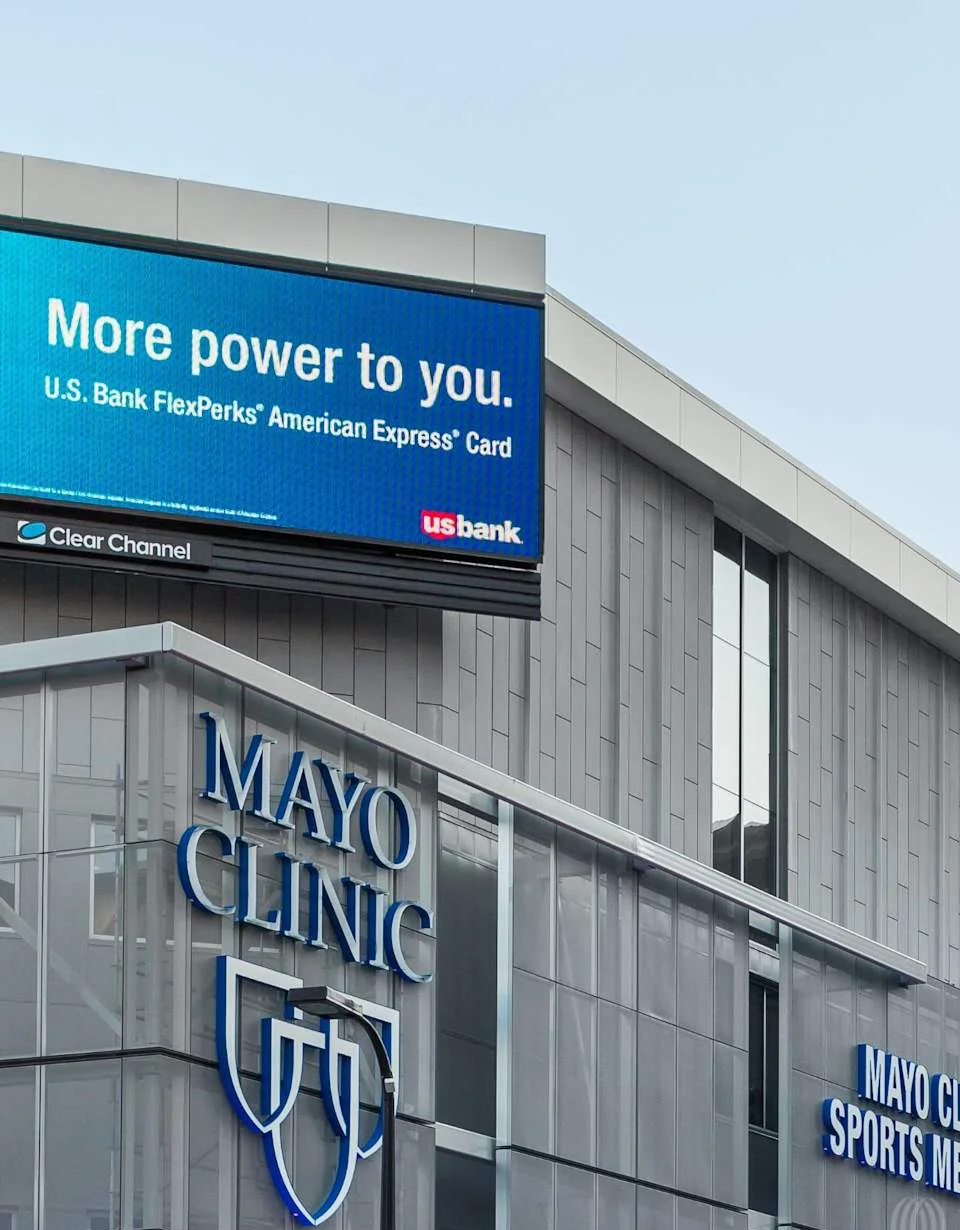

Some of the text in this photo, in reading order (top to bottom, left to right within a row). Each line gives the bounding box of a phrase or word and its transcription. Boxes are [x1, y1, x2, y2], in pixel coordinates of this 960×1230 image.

[47, 297, 513, 408] More power to you.
[44, 375, 88, 403] U.S.
[93, 381, 148, 411] Bank
[268, 405, 367, 440] American
[466, 430, 512, 459] Card
[49, 526, 191, 560] Clear Channel
[422, 513, 524, 545] usbank
[199, 711, 417, 870] MAYO
[176, 823, 435, 984] CLINIC
[857, 1043, 930, 1120] MAYO
[822, 1097, 924, 1182] SPORTS
